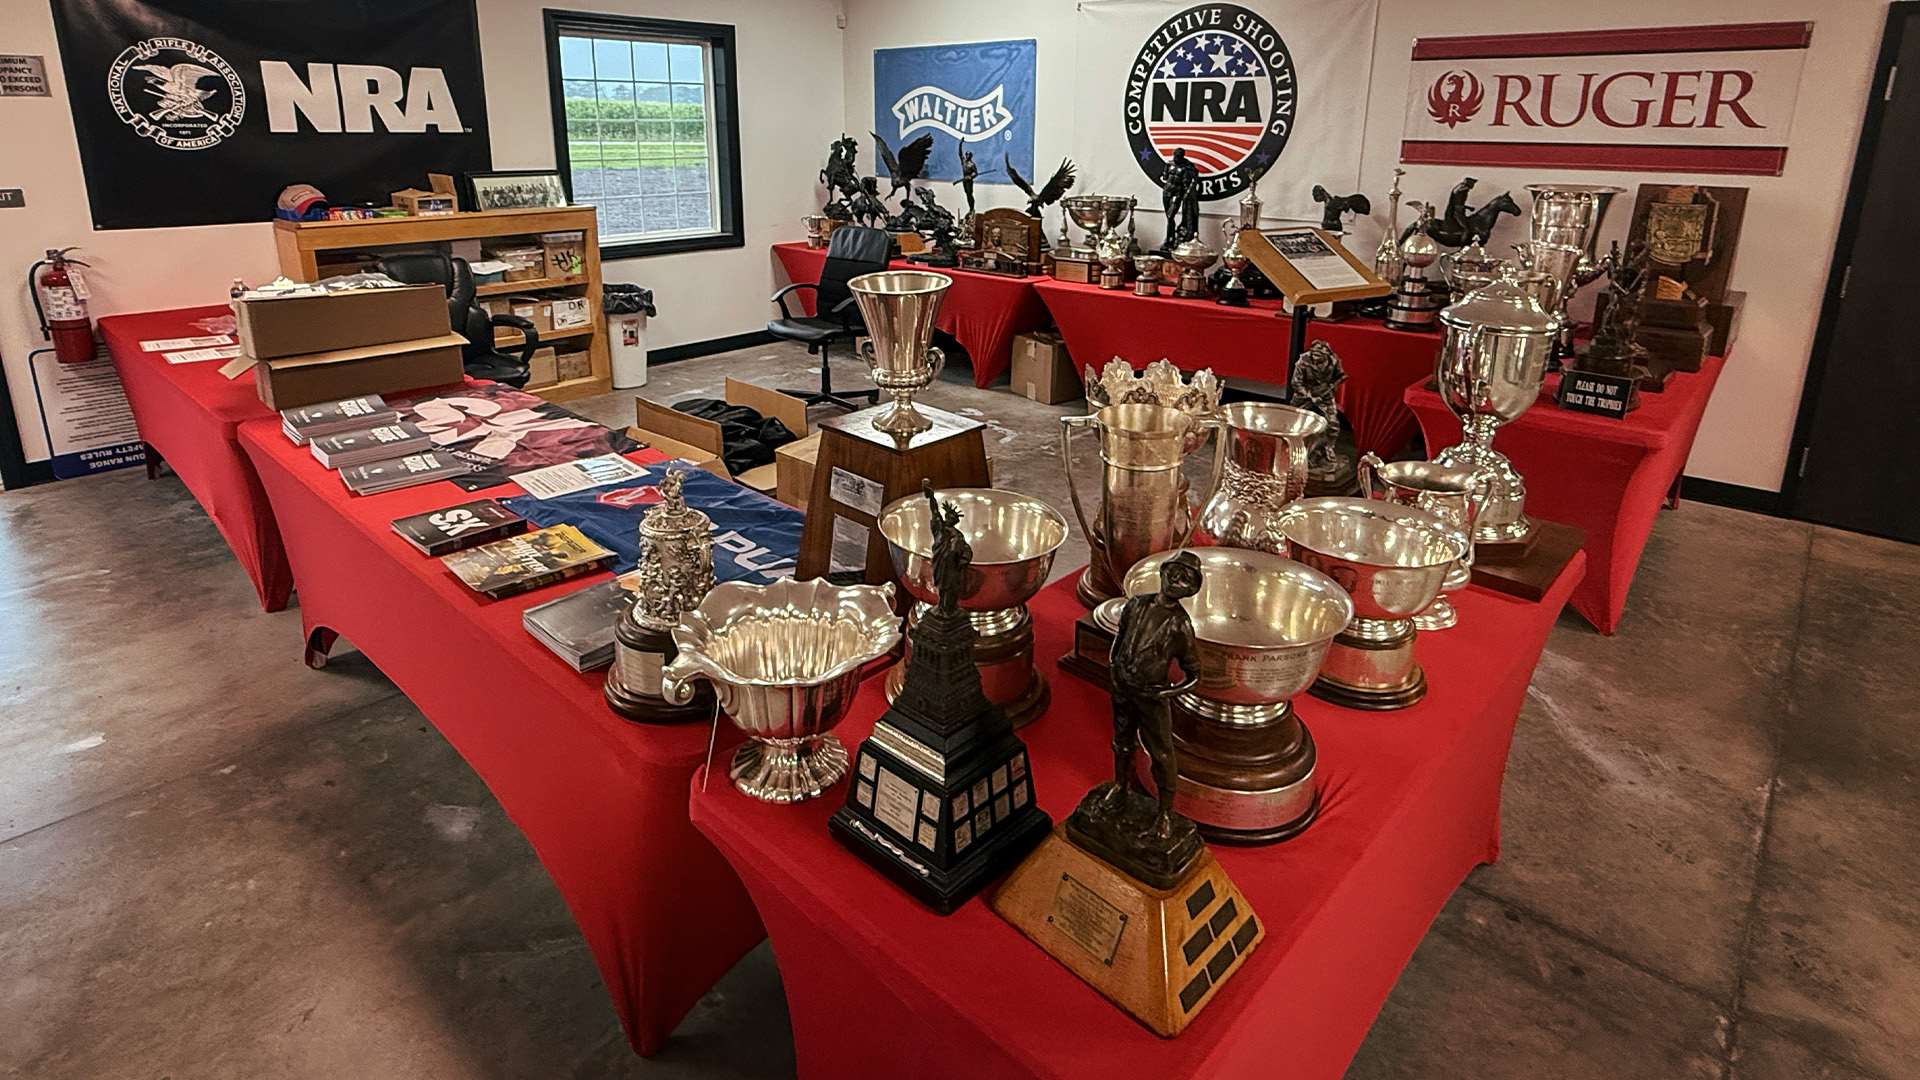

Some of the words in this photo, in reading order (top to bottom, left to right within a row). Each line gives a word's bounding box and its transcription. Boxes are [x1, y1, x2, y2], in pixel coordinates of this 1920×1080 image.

[154, 39, 189, 49] RIFLE
[8, 76, 42, 84] EXCEED
[1127, 8, 1222, 135] COMPETITIVE
[1233, 13, 1292, 137] SHOOTING
[110, 59, 129, 114] NATIONAL
[210, 57, 244, 119] ASSOCIATION
[259, 60, 464, 133] NRA
[1488, 70, 1767, 130] RUGER
[904, 95, 998, 133] WALTHER
[1150, 80, 1262, 123] NRA
[160, 137, 173, 146] OF
[176, 135, 218, 148] AMERICA
[1584, 395, 1595, 406] THE
[1596, 383, 1604, 393] DO
[1606, 385, 1618, 395] NOT
[80, 450, 112, 460] RULES
[89, 458, 123, 468] RANGE
[428, 509, 490, 536] SK
